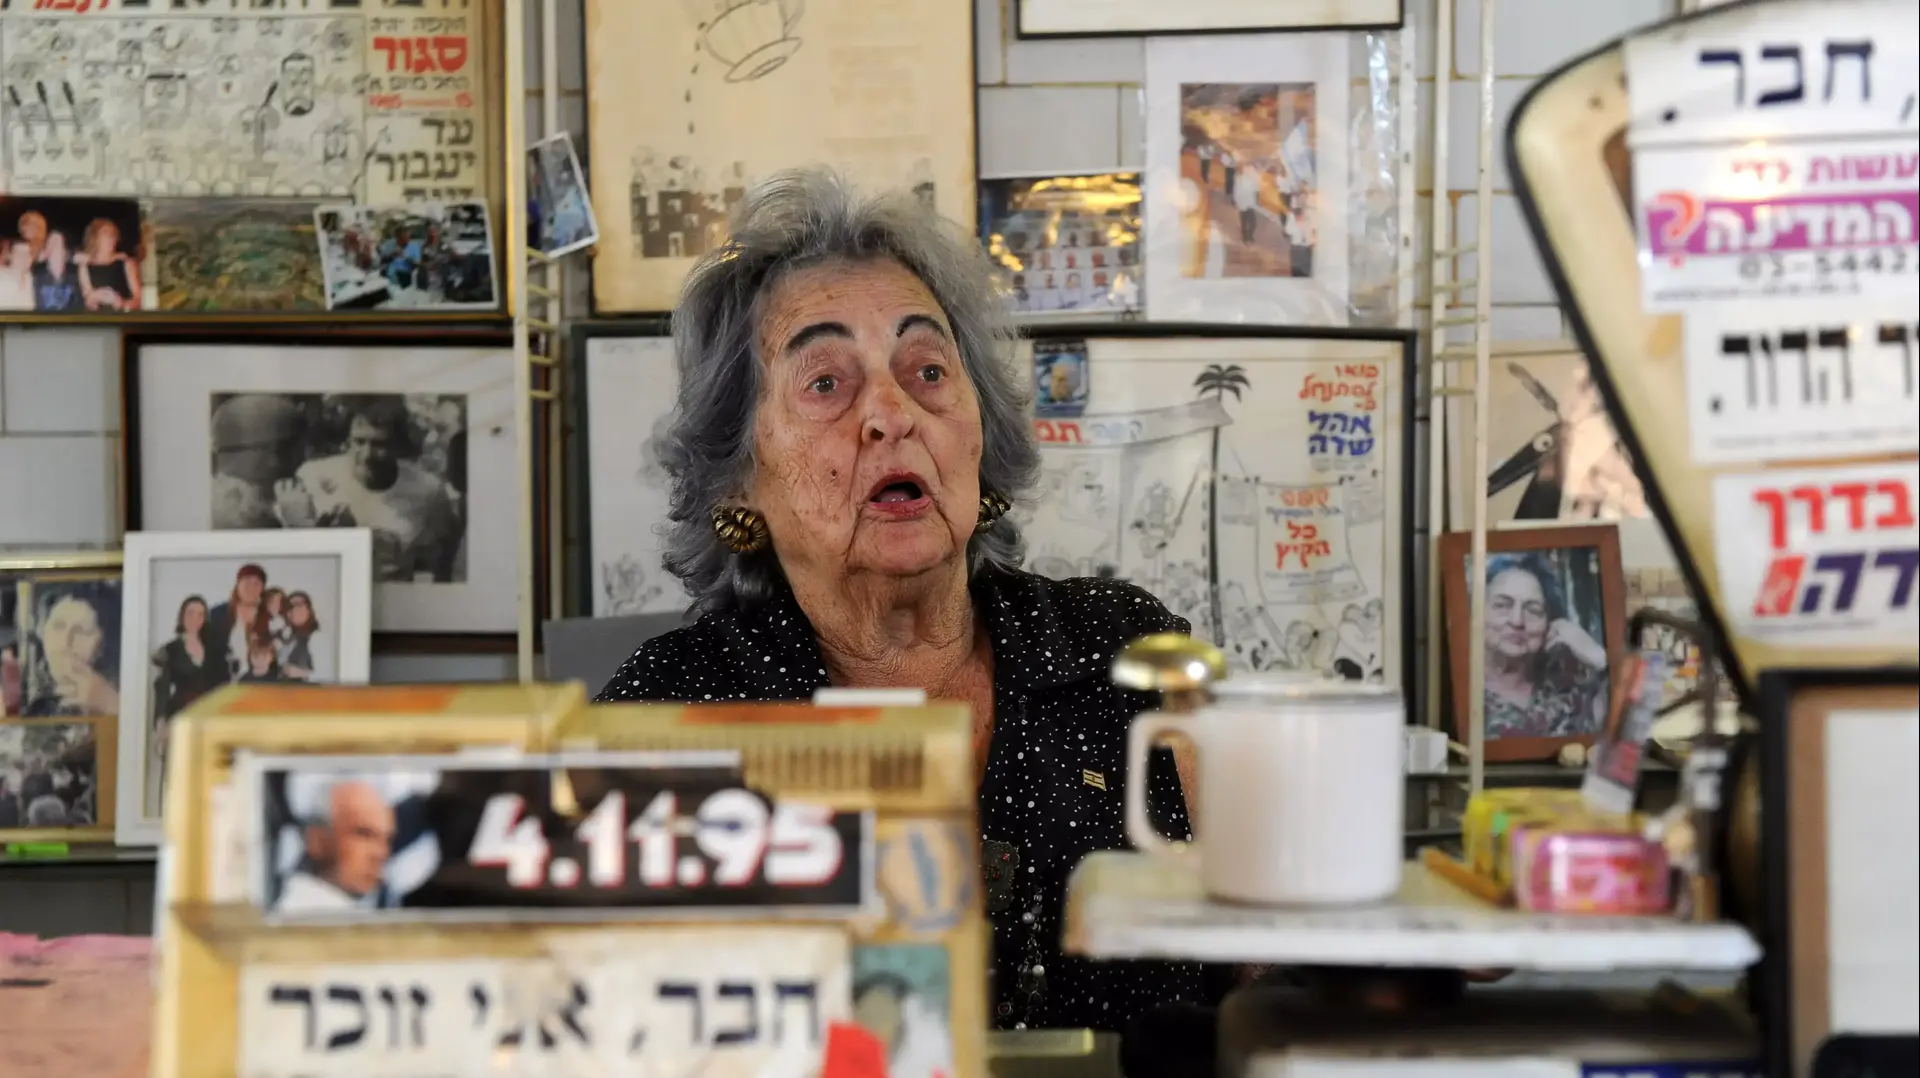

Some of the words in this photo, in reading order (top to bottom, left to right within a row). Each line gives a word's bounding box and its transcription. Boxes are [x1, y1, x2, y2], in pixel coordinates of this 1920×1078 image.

[373, 36, 468, 74] סגור
[422, 117, 473, 146] עד
[375, 151, 476, 182] יעבור
[1807, 152, 1918, 184] עשות
[1738, 246, 1918, 281] 03-5442
[1032, 419, 1083, 443] תמ
[1308, 410, 1372, 434] אהל
[1308, 434, 1375, 456] שרה
[1752, 478, 1914, 549] בדרך
[1287, 520, 1317, 539] כל
[1276, 540, 1331, 570] הקיץ
[1801, 549, 1918, 613] דה
[467, 788, 844, 888] 4.11.95
[270, 988, 430, 1050] זוכר
